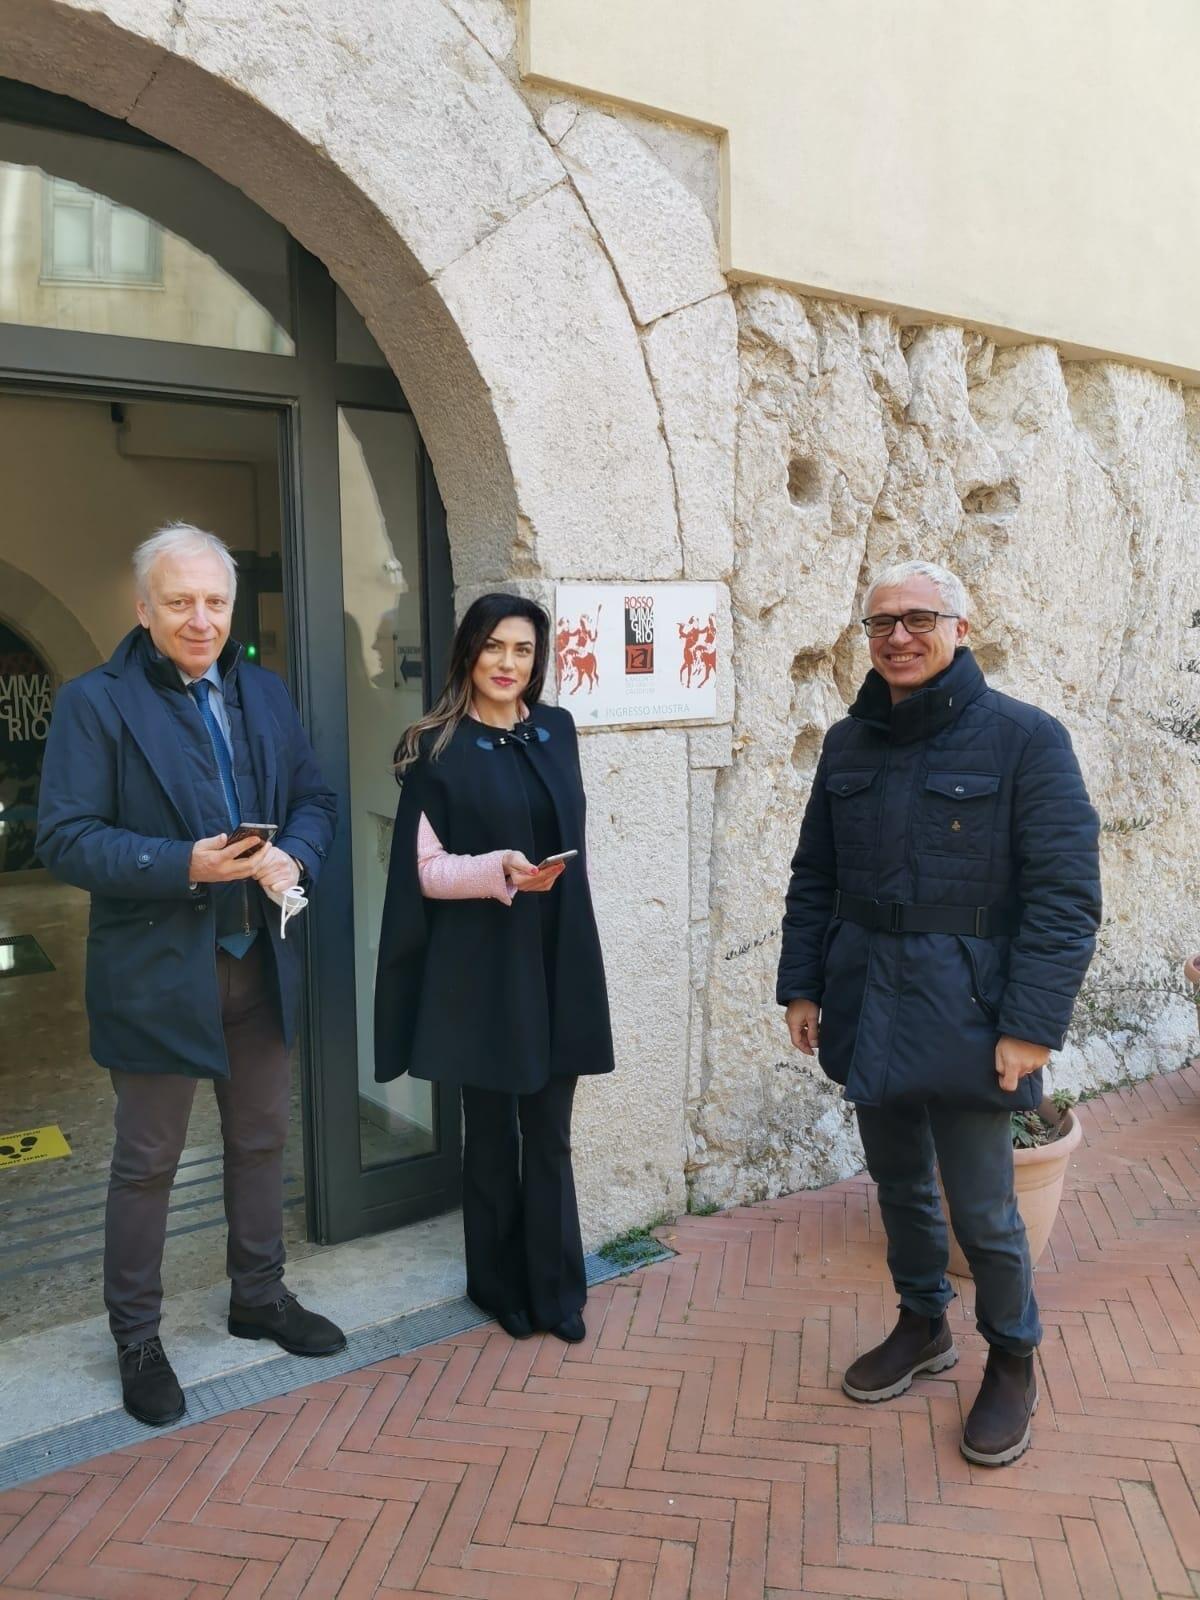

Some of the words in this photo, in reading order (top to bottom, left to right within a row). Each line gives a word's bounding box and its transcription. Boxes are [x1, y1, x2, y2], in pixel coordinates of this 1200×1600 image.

[624, 596, 654, 609] ROSSO
[629, 607, 654, 621] IMMA
[631, 619, 654, 632] GINA
[635, 630, 653, 643] RIO
[606, 705, 650, 718] INGRESSO
[653, 703, 690, 715] MOSTRA
[8, 717, 50, 741] RIO
